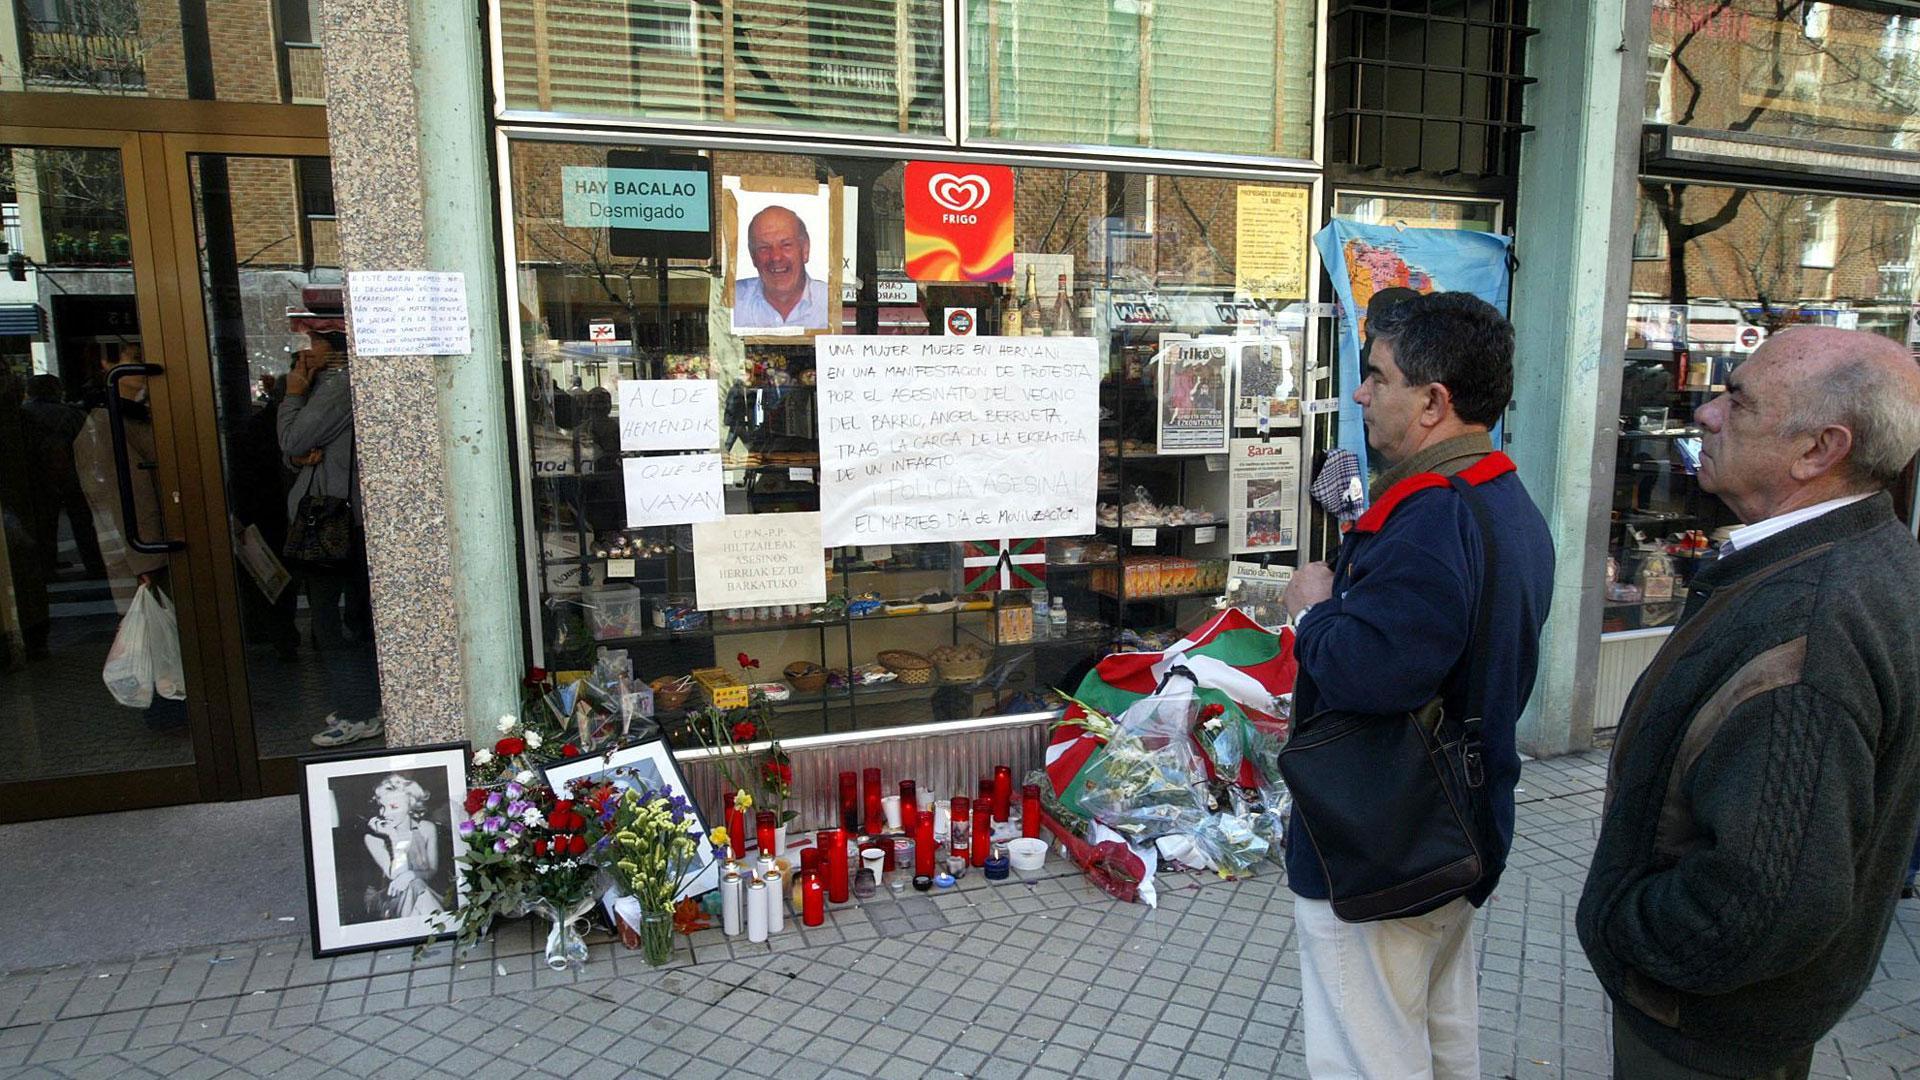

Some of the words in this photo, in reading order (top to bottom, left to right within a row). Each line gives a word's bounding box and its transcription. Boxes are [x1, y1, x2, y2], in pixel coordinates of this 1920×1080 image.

[575, 180, 608, 194] HAY
[614, 181, 696, 197] BACALAO
[590, 202, 685, 222] Desmigado
[943, 213, 978, 225] FRIGO
[362, 274, 380, 282] ESTE
[829, 344, 854, 358] UNA
[863, 344, 910, 358] MUJER
[922, 344, 965, 358] MUERE
[973, 344, 991, 356] EN
[827, 366, 845, 380] EN
[853, 367, 876, 378] UNA
[996, 365, 1015, 379] DE
[1022, 364, 1093, 380] PROTESTA
[629, 386, 708, 409] ALDE
[828, 389, 854, 404] POR
[864, 388, 880, 402] EL
[892, 387, 977, 402] ASESINATO
[984, 387, 1015, 402] DEL
[1022, 388, 1076, 401] VECINO
[622, 418, 717, 439] HEMENDIK
[830, 416, 861, 433] DEL
[835, 443, 880, 461] TRAS
[890, 438, 908, 454] LA
[914, 431, 962, 447] CARGA
[971, 432, 991, 446] DE
[996, 432, 1011, 446] LA
[1248, 445, 1275, 457] gara
[642, 464, 688, 480] QUE
[691, 460, 719, 474] SE
[836, 467, 855, 483] DE
[865, 462, 883, 476] UN
[891, 454, 954, 473] INFARTO
[641, 490, 722, 513] VAYAN
[855, 514, 875, 534] EL
[882, 512, 939, 532] MARTES
[723, 540, 796, 553] HILTZAILEAK
[736, 553, 788, 565] ASESINOS
[719, 567, 769, 579] HERRIAK
[772, 566, 785, 576] EZ
[1237, 565, 1258, 577] Diario
[1258, 568, 1267, 577] de
[1267, 568, 1291, 580] Navarra
[727, 579, 798, 592] BARKATUKO
